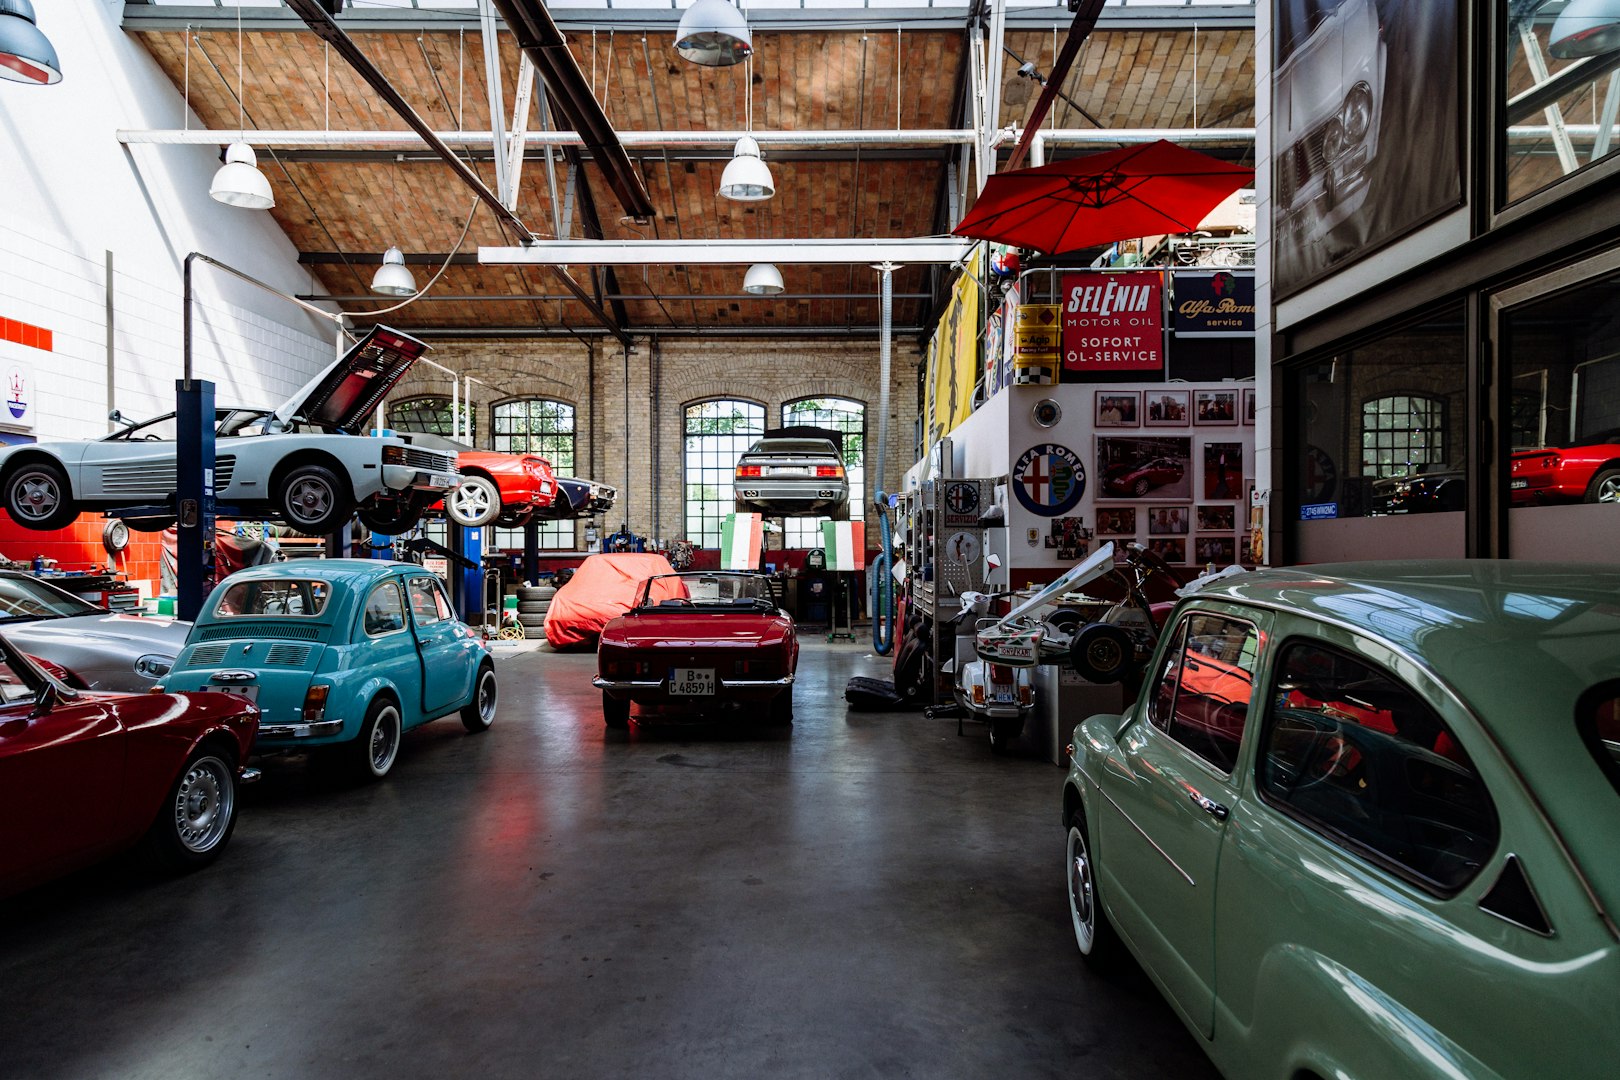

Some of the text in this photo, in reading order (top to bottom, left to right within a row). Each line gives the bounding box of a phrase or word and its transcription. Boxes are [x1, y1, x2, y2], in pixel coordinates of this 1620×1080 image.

[1068, 277, 1152, 316] SELÈNIA
[1179, 300, 1215, 319] Alfa
[1067, 318, 1154, 327] MOTOR OIL
[1206, 319, 1243, 327] service
[1029, 336, 1050, 345] Agip
[1081, 337, 1142, 348] SOFORT
[1067, 350, 1157, 362] ÖL-SERVICE
[1014, 445, 1085, 482] ALFA ROMEO
[947, 514, 978, 524] SERVIZIO
[687, 670, 695, 681] B
[670, 682, 714, 693] C 4859 H
